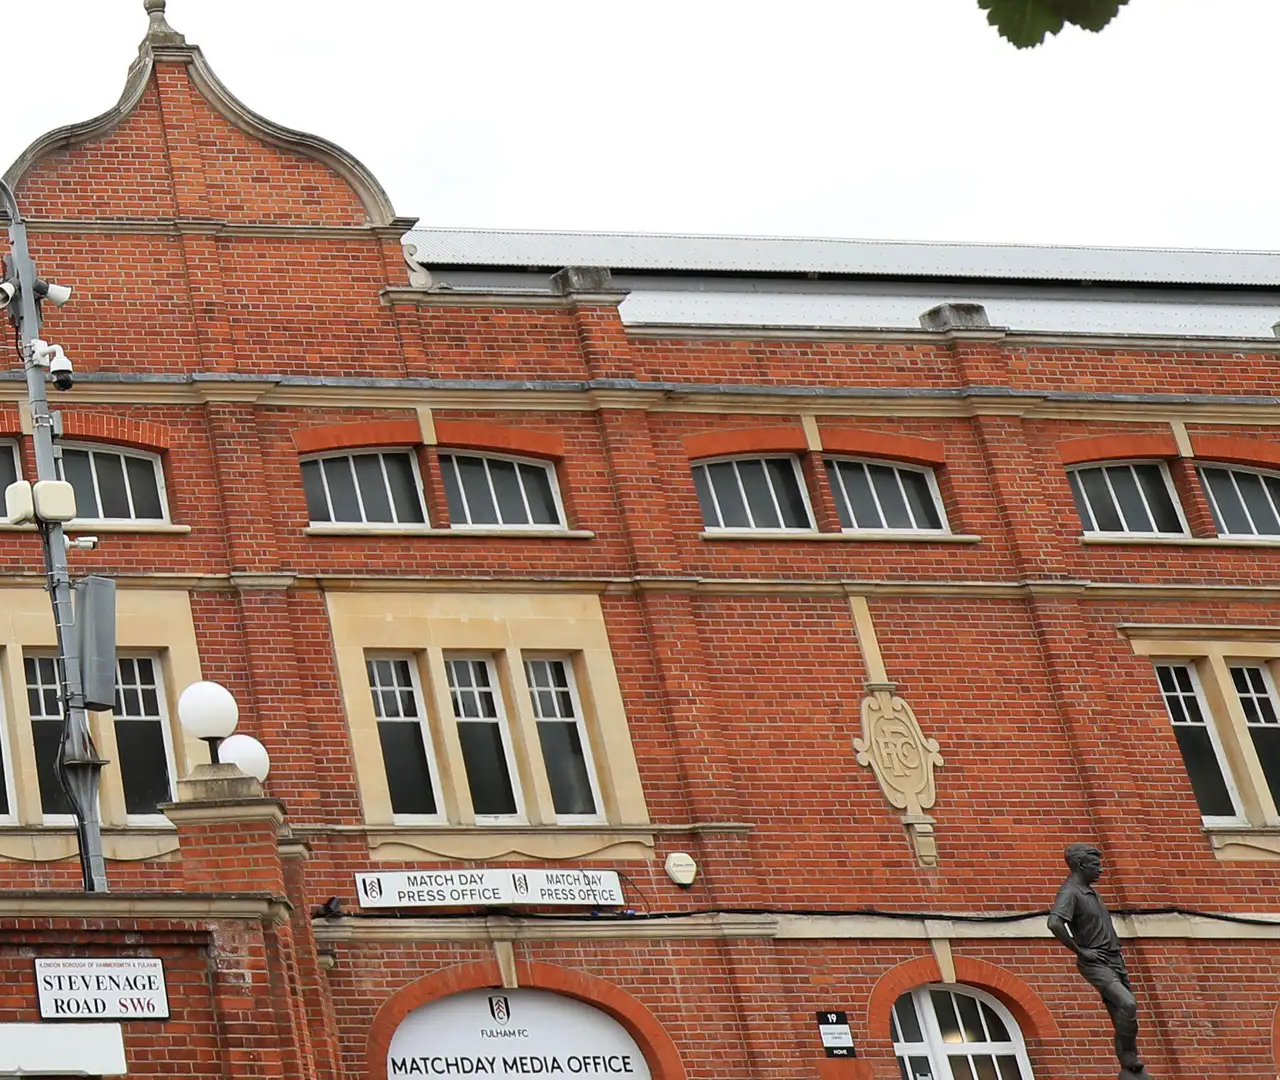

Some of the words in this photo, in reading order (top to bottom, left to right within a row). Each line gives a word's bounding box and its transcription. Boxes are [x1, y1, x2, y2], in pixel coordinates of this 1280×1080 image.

[407, 875, 456, 887] MATCH
[458, 874, 484, 886] DAY
[546, 874, 581, 886] MATCH
[583, 874, 603, 886] DAY
[398, 890, 446, 902] PRESS
[449, 888, 502, 900] OFFICE
[540, 888, 576, 900] PRESS
[578, 888, 616, 900] OFFICE
[43, 974, 160, 991] STEVENAGE
[53, 998, 106, 1014] ROAD
[118, 998, 156, 1014] SW6
[827, 1013, 837, 1023] 19
[480, 1029, 516, 1038] FULHAM
[517, 1029, 529, 1038] FC
[391, 1056, 497, 1075] MATCHDAY
[502, 1056, 564, 1074] MEDIA
[567, 1055, 634, 1074] OFFICE
